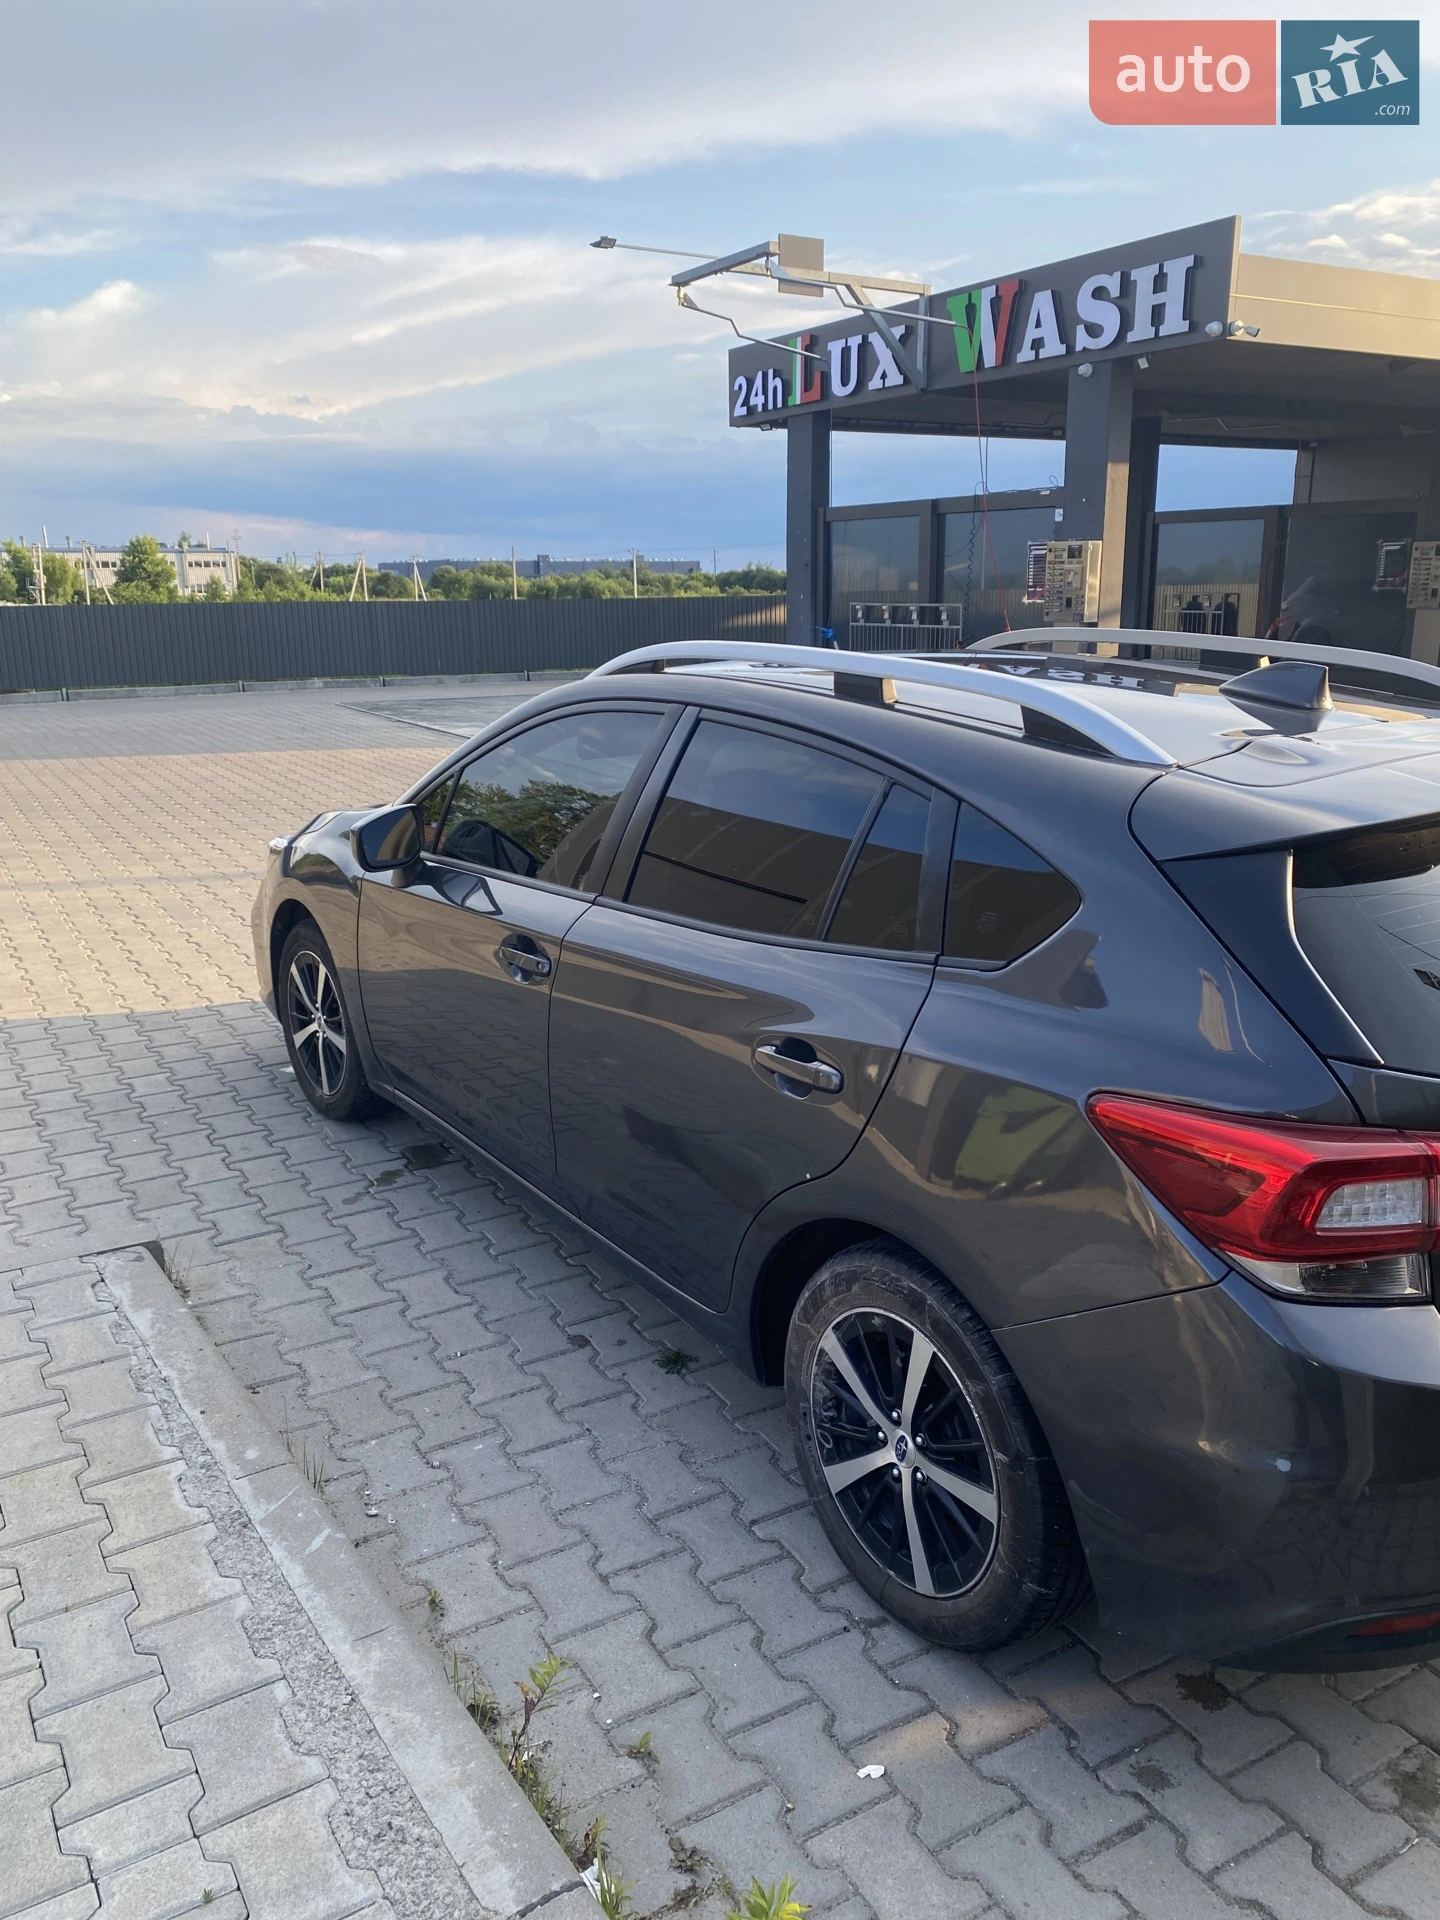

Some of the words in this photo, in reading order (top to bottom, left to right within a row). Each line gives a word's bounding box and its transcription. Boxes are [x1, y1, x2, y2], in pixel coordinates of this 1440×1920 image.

[733, 367, 783, 417] 24h
[787, 325, 906, 407] LUX
[946, 254, 1195, 373] WASH
